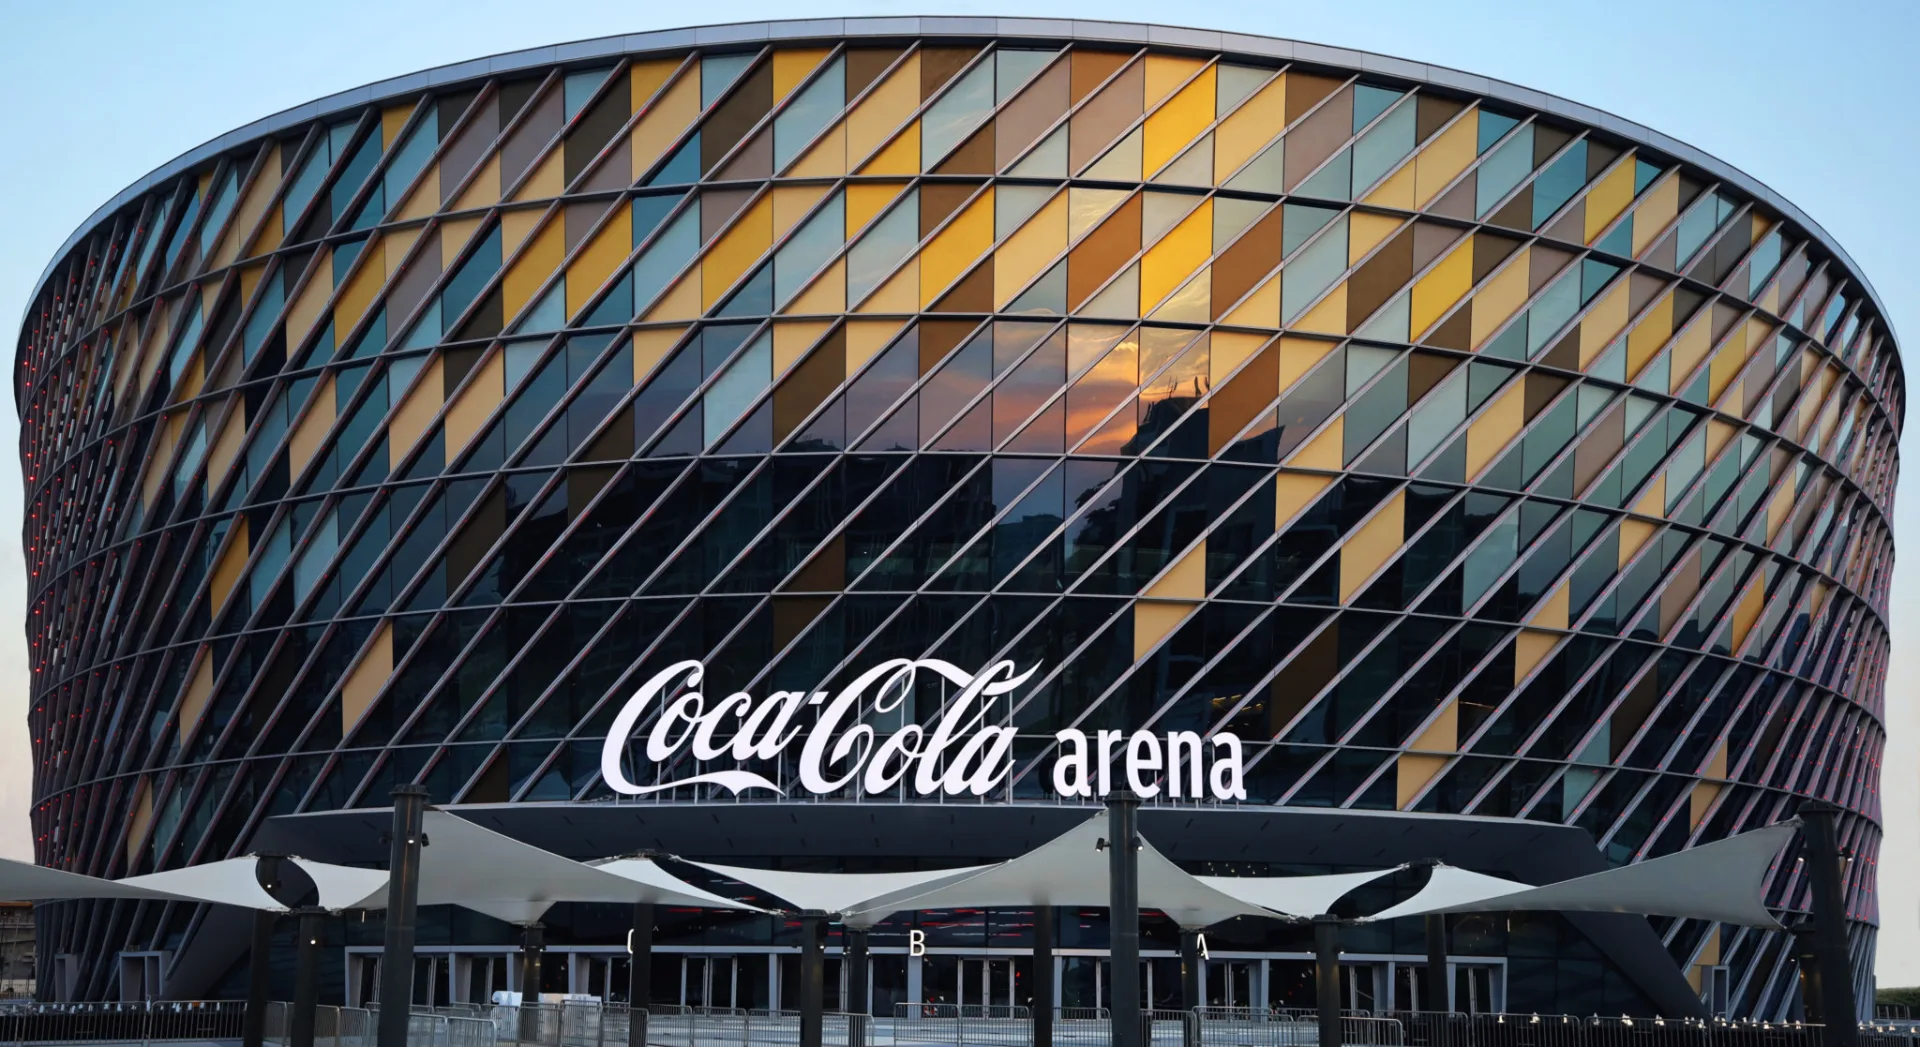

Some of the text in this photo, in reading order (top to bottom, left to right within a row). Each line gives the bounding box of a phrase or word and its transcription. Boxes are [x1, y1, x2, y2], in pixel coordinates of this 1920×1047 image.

[602, 659, 1247, 800] Coca-Cola arena
[910, 929, 926, 957] B
[1196, 933, 1210, 961] A
